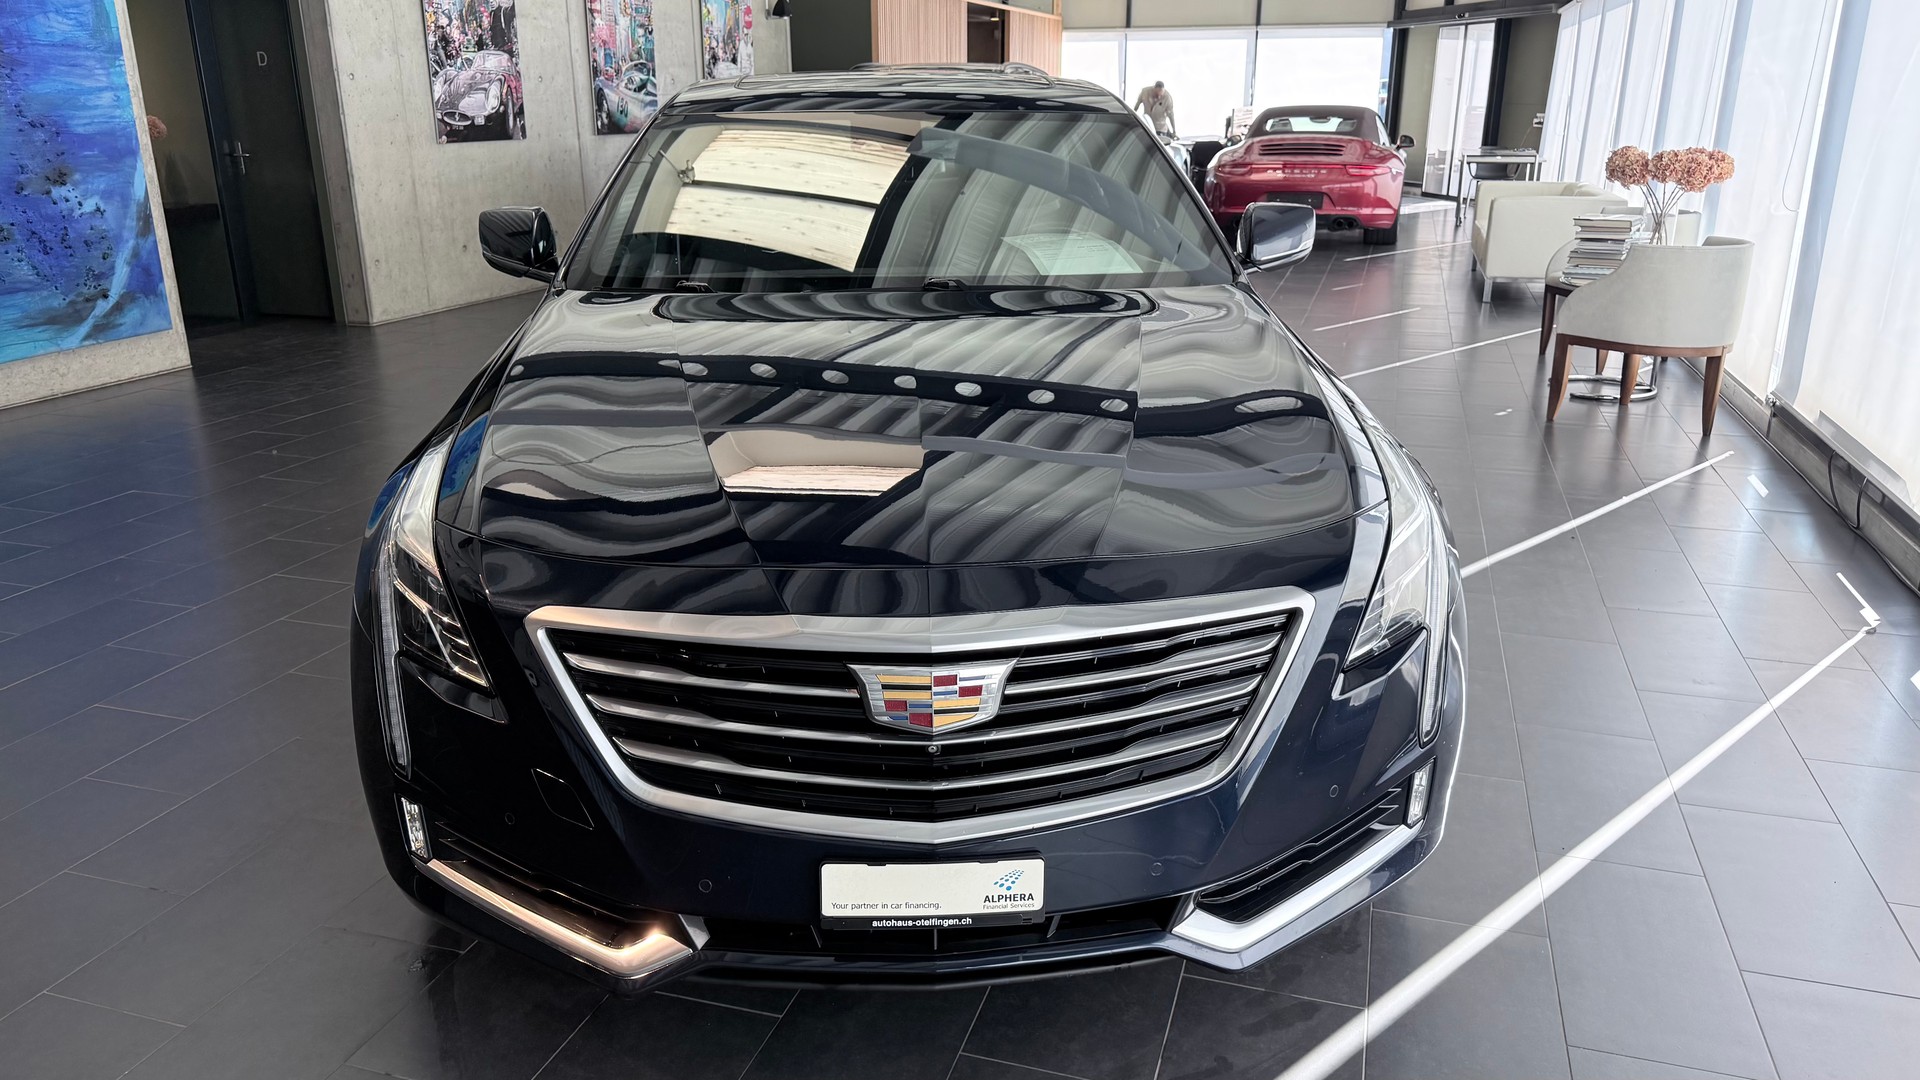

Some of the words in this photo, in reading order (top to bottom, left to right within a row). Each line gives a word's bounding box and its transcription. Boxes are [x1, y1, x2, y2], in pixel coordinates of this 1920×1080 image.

[256, 51, 267, 66] D
[983, 892, 1035, 903] ALPHERA
[831, 902, 849, 910] Your
[851, 902, 879, 910] partner
[904, 901, 942, 910] financing.
[872, 917, 972, 927] autohaus-otelfingen.ch
